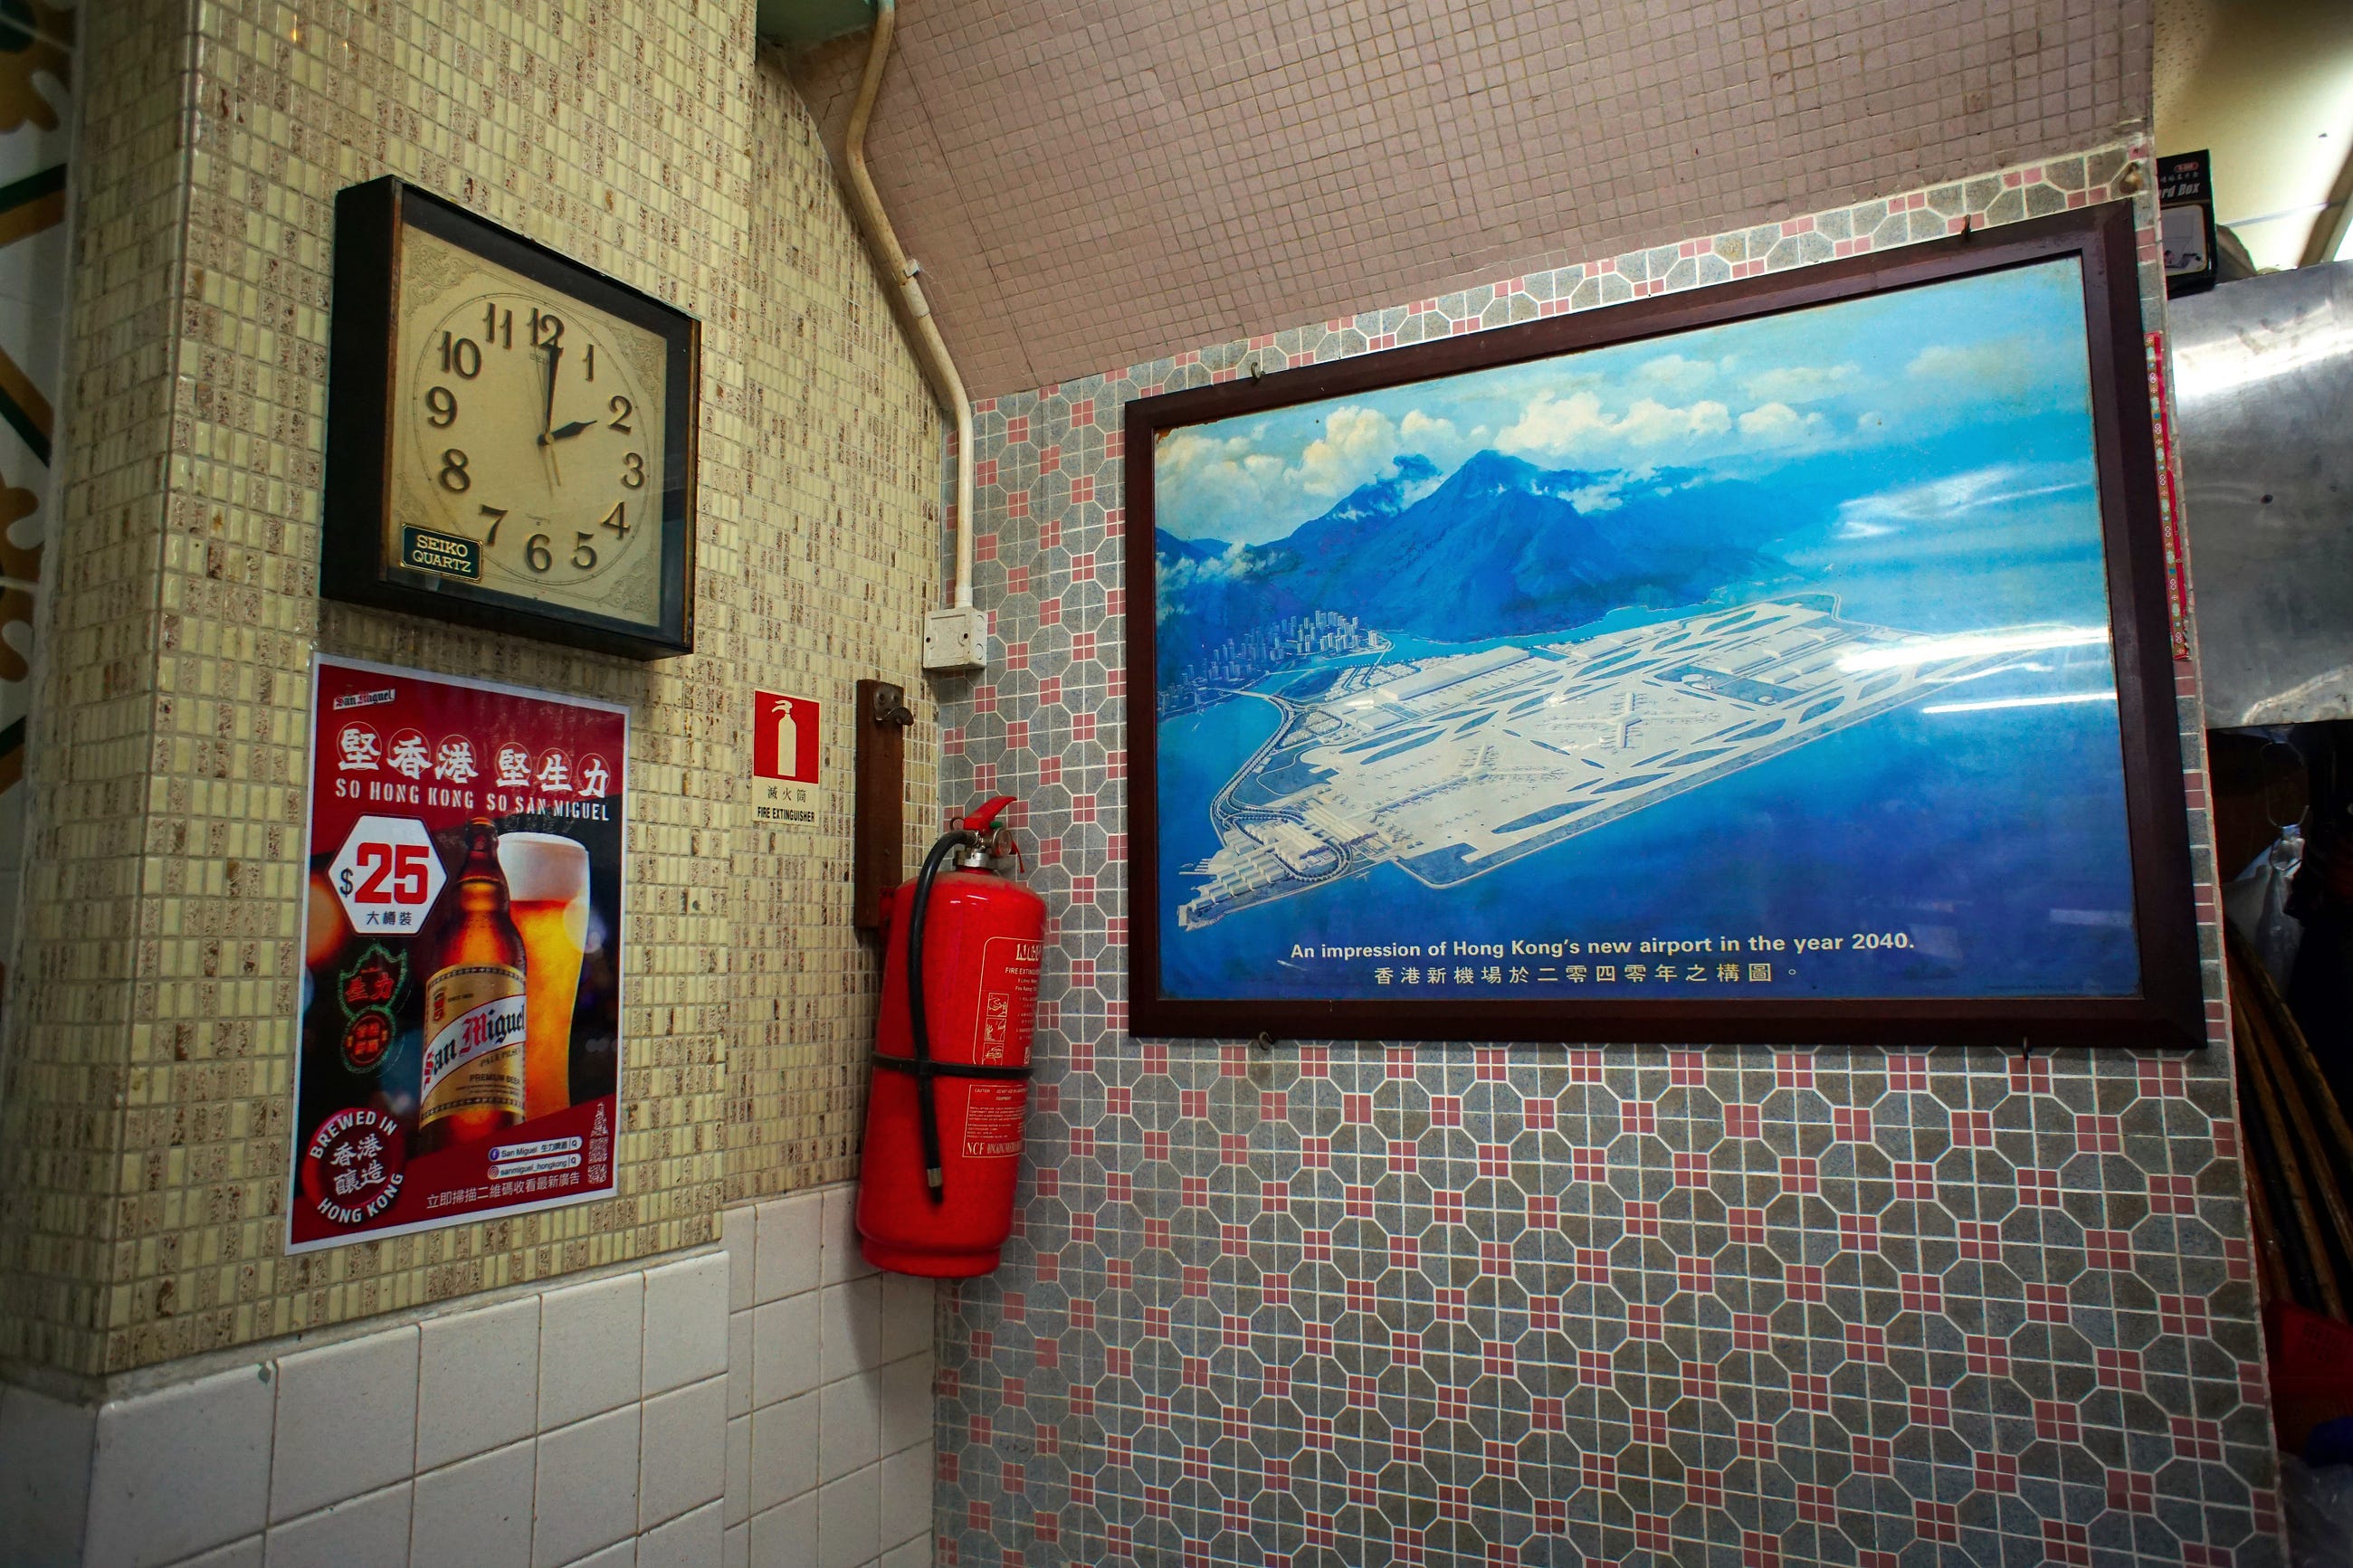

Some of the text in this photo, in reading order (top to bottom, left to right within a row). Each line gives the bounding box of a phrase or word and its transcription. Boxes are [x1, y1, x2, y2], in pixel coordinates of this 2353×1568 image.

[482, 302, 513, 350] 11
[526, 308, 565, 357] 12
[438, 330, 481, 380] 10
[583, 344, 595, 382] 1
[425, 385, 458, 429] 9
[608, 395, 633, 435] 2
[438, 448, 472, 493] 8
[621, 452, 645, 489] 3
[479, 503, 509, 546] 7
[599, 501, 632, 540] 4
[412, 549, 472, 573] QUARTZ
[416, 534, 469, 558] SEIKO
[526, 533, 553, 573] 6
[571, 530, 597, 570] 5
[338, 728, 609, 798] 堅香港 堅生力
[335, 778, 610, 822] SO HONG KONG SO SAN MIGUEL
[757, 806, 815, 822] FIRE EXTINGUISHER
[1291, 933, 1914, 961] An impression of Hong Kong's new airport in the year 2040.
[424, 1038, 457, 1087] San
[458, 1004, 525, 1057] Miguel
[470, 1073, 505, 1082] PREMIUM
[310, 1111, 398, 1159] BREWED IN
[329, 1133, 384, 1167] 香港
[500, 1149, 515, 1158] San
[516, 1145, 538, 1155] Miguel
[317, 1173, 405, 1223] HONG KONG
